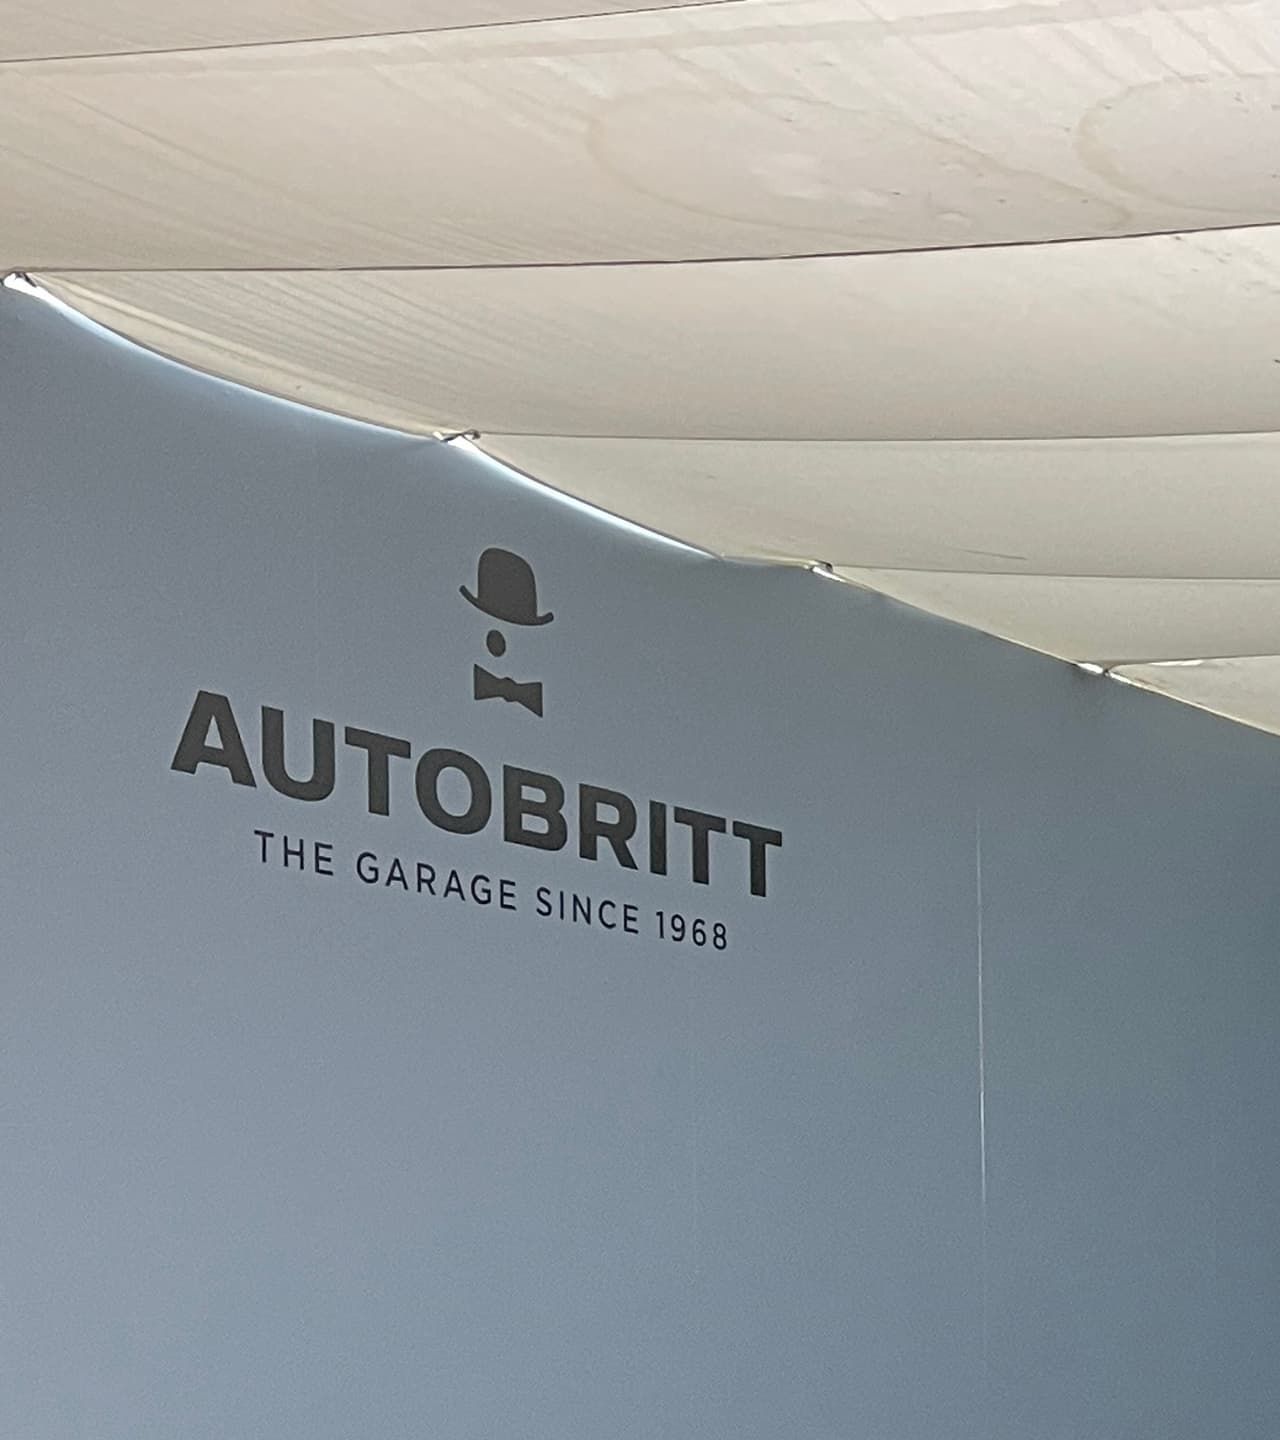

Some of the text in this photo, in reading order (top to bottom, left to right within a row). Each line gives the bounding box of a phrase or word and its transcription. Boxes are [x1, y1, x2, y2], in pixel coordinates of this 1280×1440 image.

[169, 689, 784, 898] AUTOBRITT
[253, 829, 728, 951] THE GARAGE SINCE 1968
